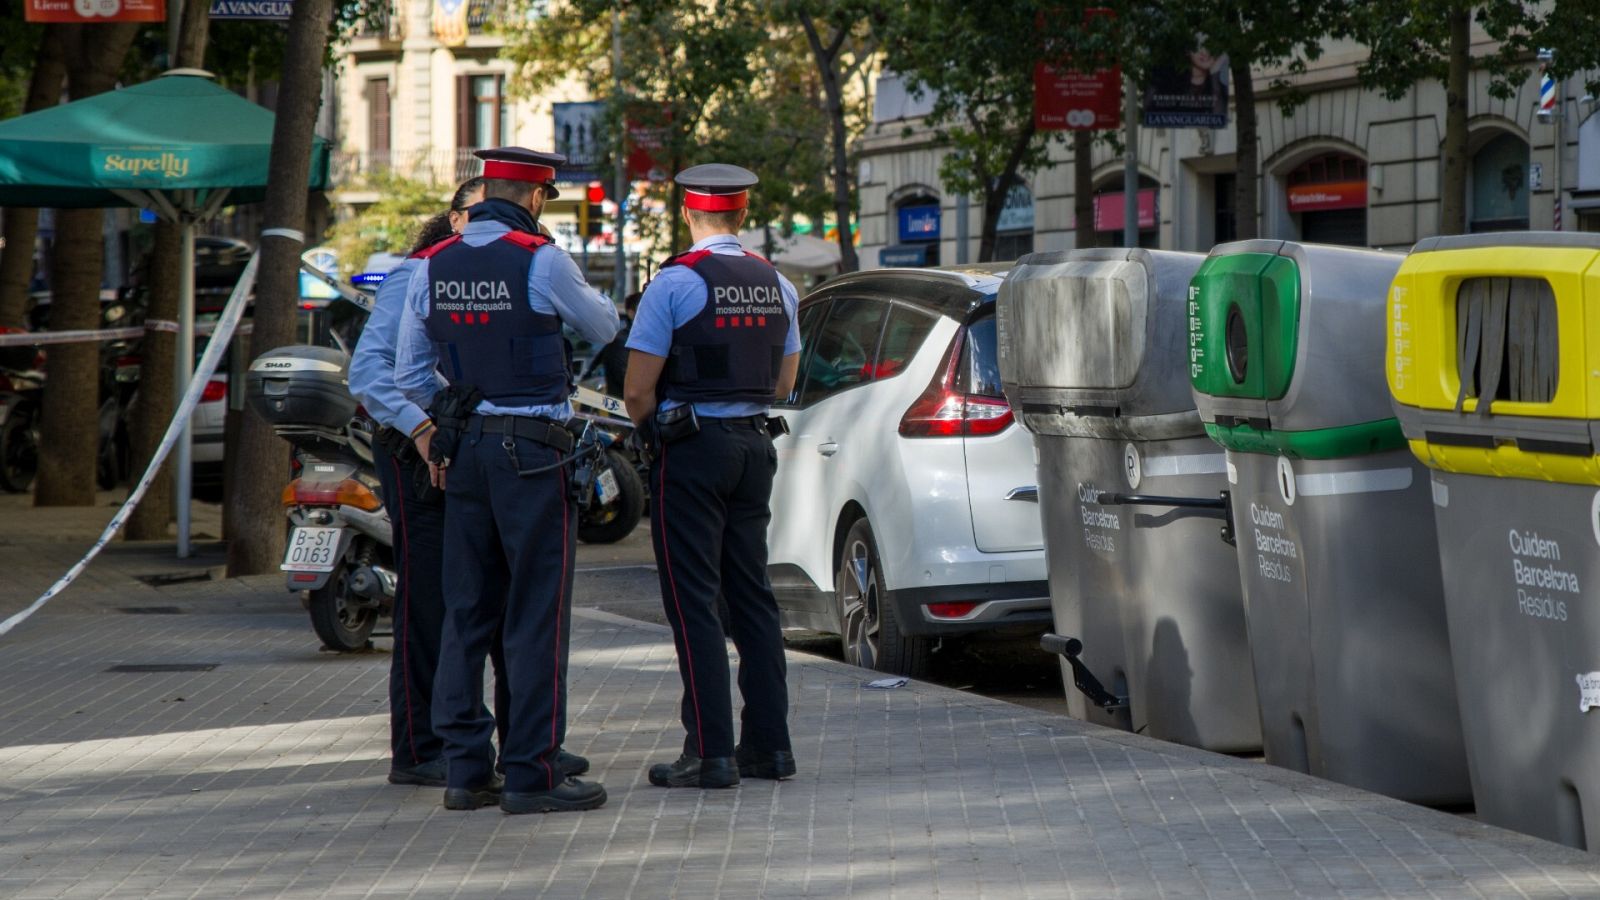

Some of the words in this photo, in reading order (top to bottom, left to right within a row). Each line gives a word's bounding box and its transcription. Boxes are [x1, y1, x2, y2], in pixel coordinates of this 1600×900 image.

[228, 1, 293, 16] VANGUA
[104, 152, 189, 178] Sapelly
[434, 280, 511, 300] POLICIA
[714, 286, 782, 305] POLICIA
[436, 302, 465, 311] mossos
[466, 301, 512, 313] d'esquadra
[715, 306, 744, 315] mossos
[745, 304, 783, 316] d'esquadra
[264, 361, 292, 369] SHAD
[1078, 482, 1106, 504] Cuide
[1081, 505, 1120, 530] Barcelona
[1251, 502, 1284, 531] Cuidem
[296, 529, 336, 546] B-ST
[1084, 527, 1115, 553] Residus
[1255, 530, 1297, 558] Barcelona
[1508, 528, 1560, 562] Cuidem
[292, 547, 330, 564] 0163
[1258, 556, 1291, 583] Residus
[1512, 558, 1580, 594] Barcelona
[1517, 588, 1567, 622] Residus
